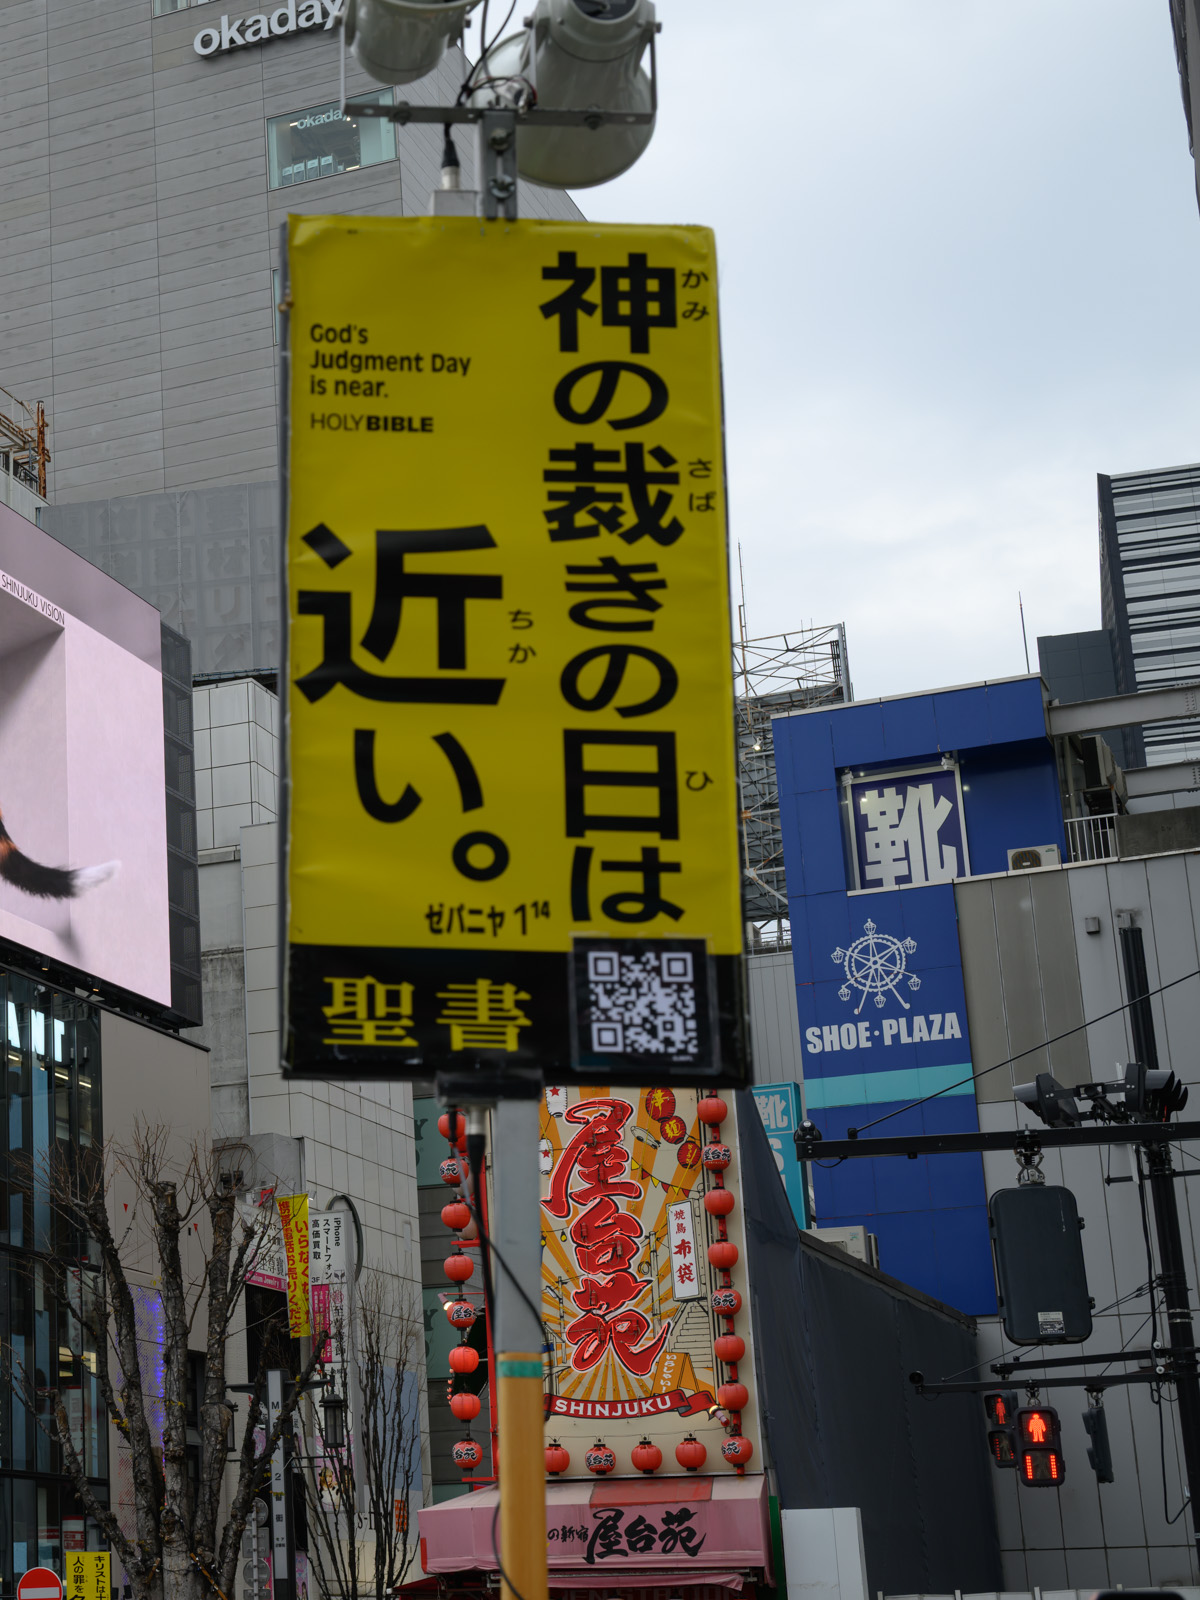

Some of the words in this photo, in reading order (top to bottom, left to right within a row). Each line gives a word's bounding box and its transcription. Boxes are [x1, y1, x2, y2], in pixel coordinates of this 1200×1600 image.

[681, 267, 710, 322] かみ
[310, 323, 369, 344] God's
[309, 349, 424, 373] Judgment
[431, 353, 471, 377] Day
[310, 375, 327, 395] is
[334, 379, 389, 398] near.
[687, 456, 716, 515] さば
[1, 574, 38, 608] SHINJUKU
[40, 598, 65, 625] VISION
[539, 251, 685, 924] 神の裁きの日は
[507, 607, 537, 664] ちか
[295, 522, 510, 882] 近い。
[685, 768, 714, 793] ひ
[860, 784, 959, 888] 靴
[321, 975, 532, 1053] 聖書
[312, 1218, 321, 1260] 高価買取
[323, 1218, 332, 1280] スマートフォン
[541, 1097, 673, 1377] 屋台苑
[278, 1200, 301, 1338] 携帯電話お売りくださ
[311, 1276, 320, 1284] 3F
[555, 1395, 672, 1416] SHINJUKU
[582, 1508, 707, 1564] 屋台苑
